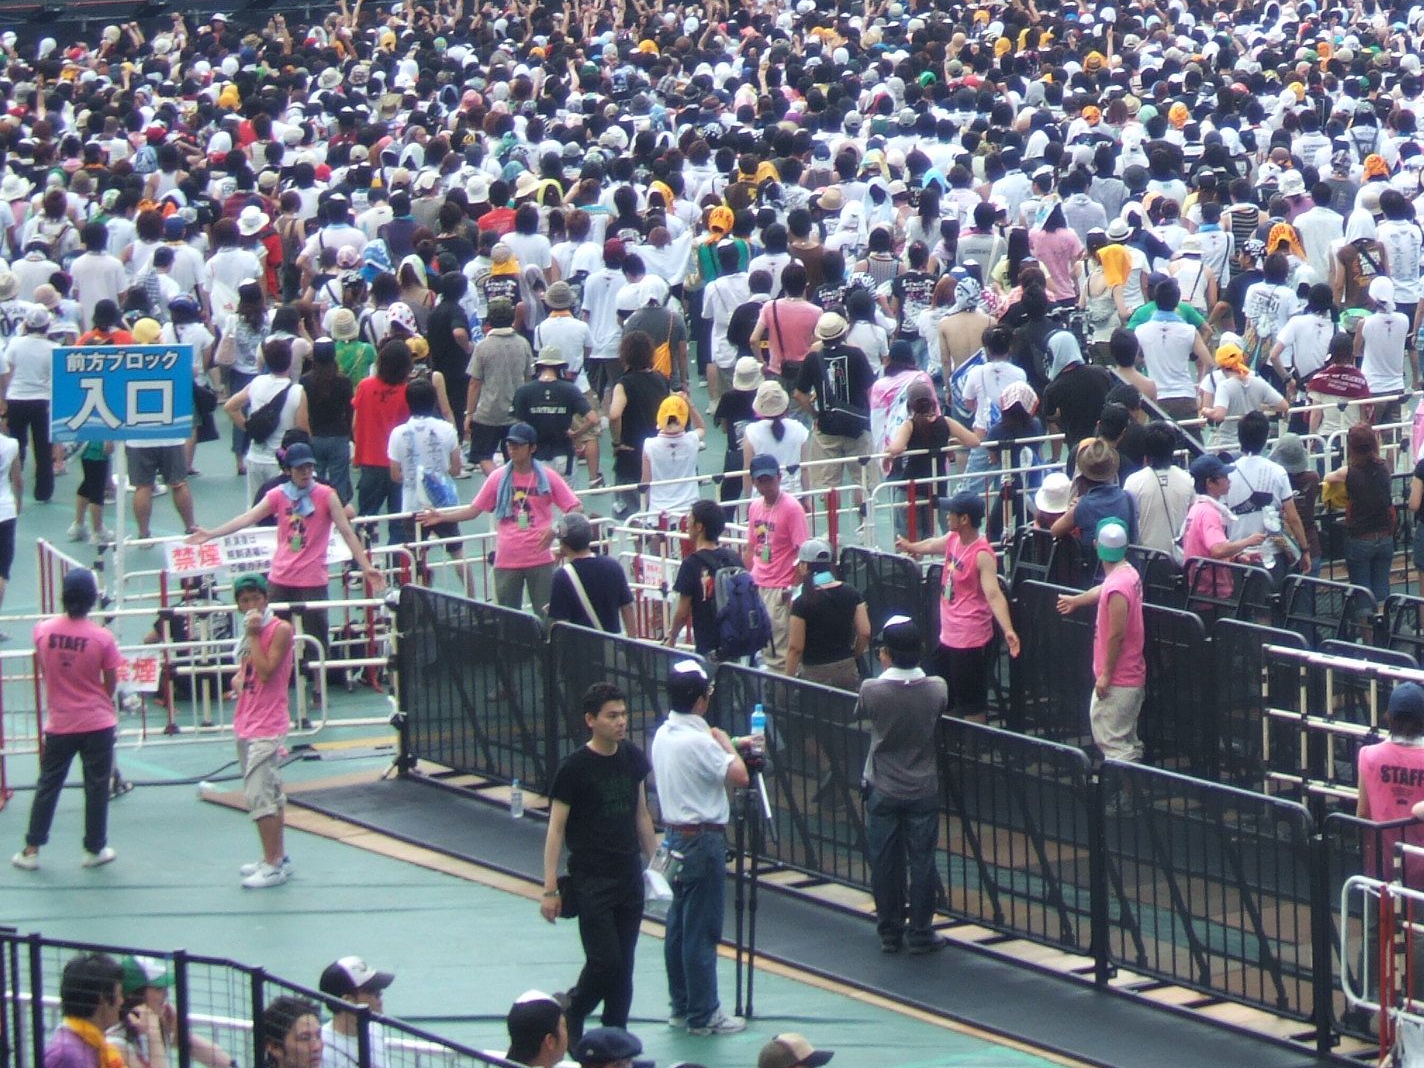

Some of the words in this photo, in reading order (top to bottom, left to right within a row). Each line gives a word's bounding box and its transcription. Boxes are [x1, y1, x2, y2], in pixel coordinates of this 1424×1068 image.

[66, 350, 179, 373] 前方ブロック
[65, 376, 174, 432] 入口
[48, 633, 89, 652] STAFF
